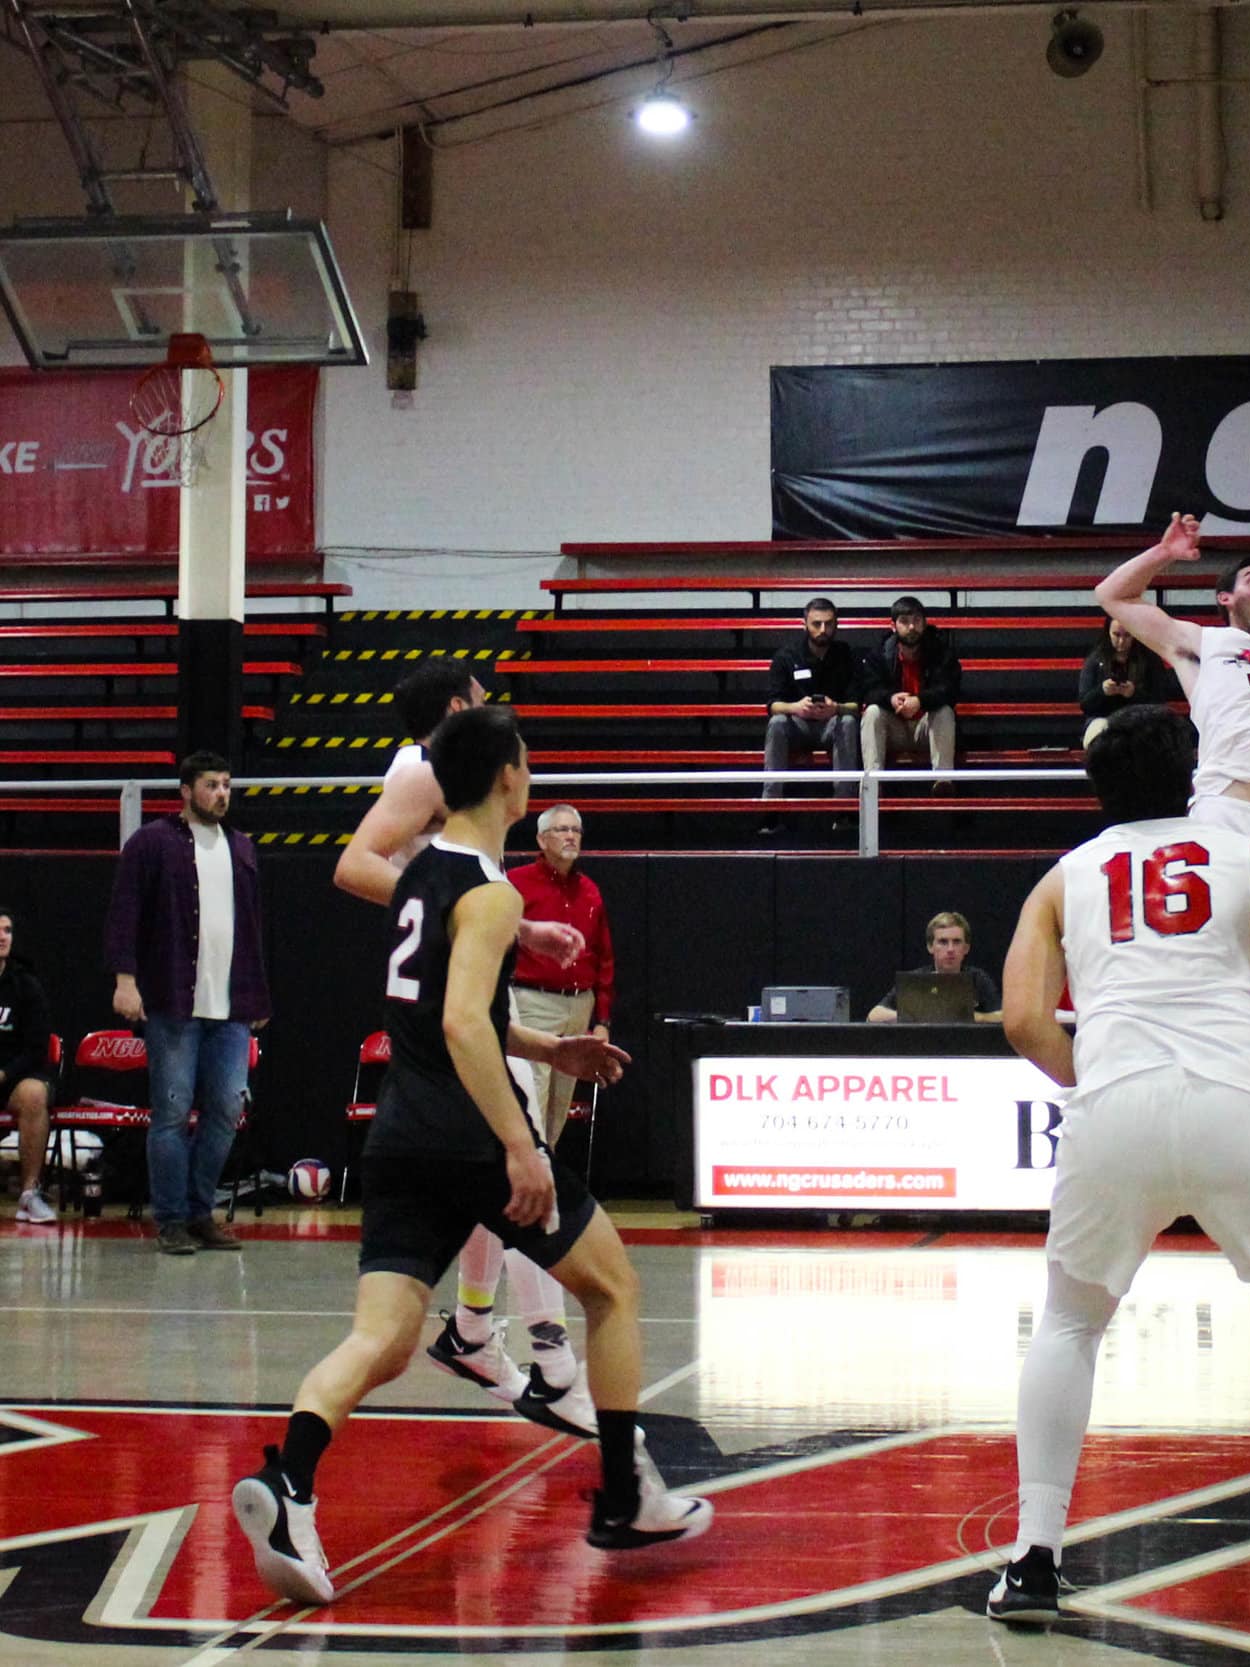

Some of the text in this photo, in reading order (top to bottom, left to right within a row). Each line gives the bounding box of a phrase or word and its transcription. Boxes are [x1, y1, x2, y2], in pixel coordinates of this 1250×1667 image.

[1100, 841, 1213, 945] 16
[386, 897, 424, 1002] 2
[709, 1075, 958, 1102] DLK APPAREL
[723, 1169, 945, 1193] www.ngcrusaders.com
